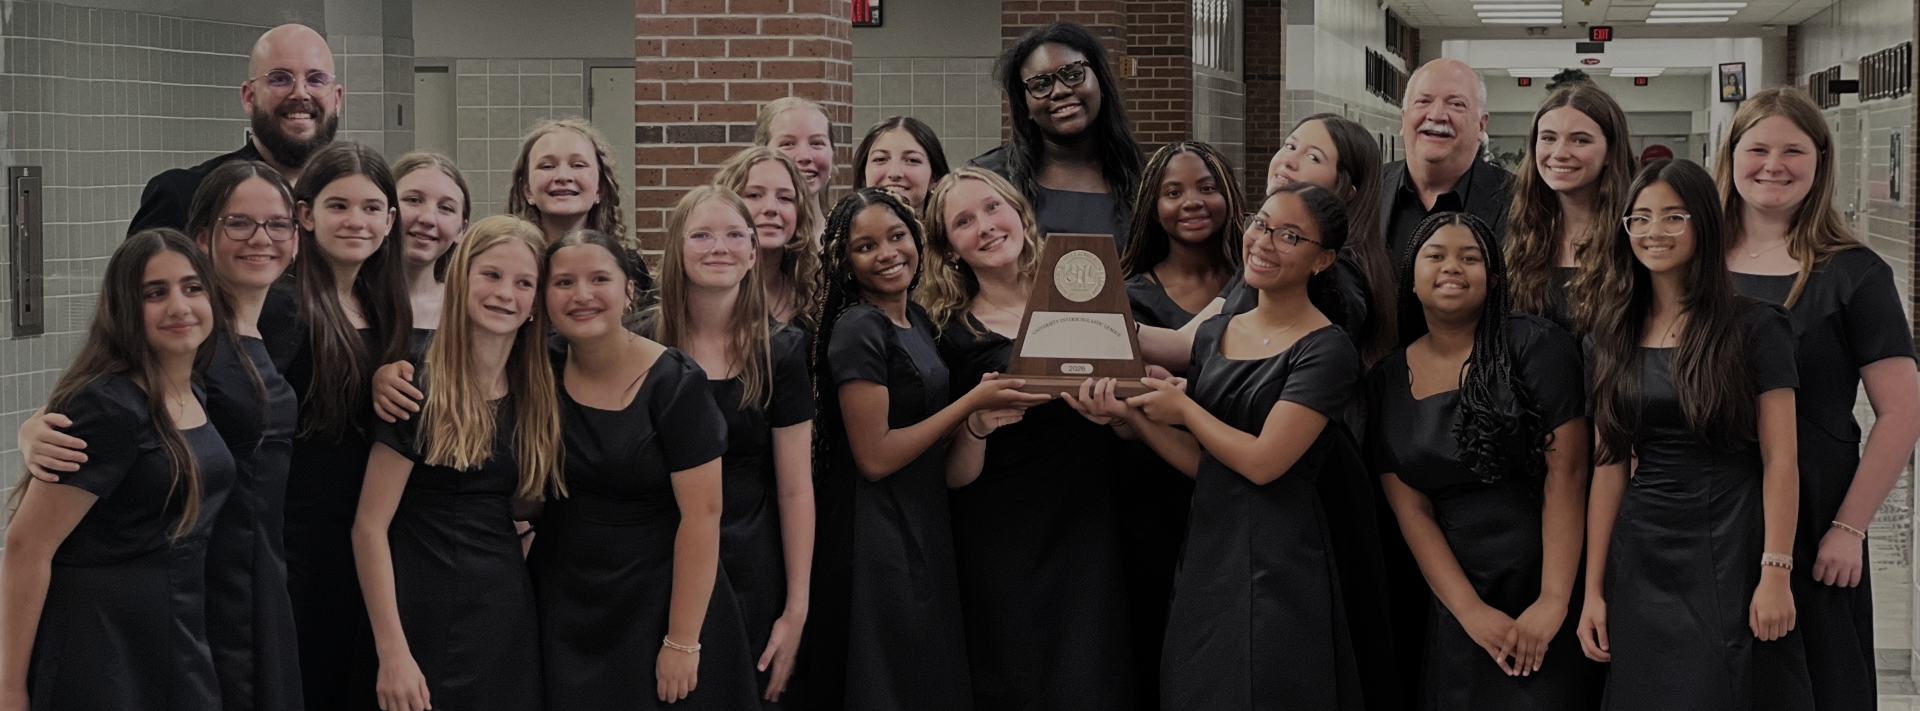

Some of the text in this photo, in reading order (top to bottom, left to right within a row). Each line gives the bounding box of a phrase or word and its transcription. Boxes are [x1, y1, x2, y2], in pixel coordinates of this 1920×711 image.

[1593, 28, 1610, 40] EXIT
[1031, 317, 1121, 338] UNIVERSITY INTERSCHOLASTIC LEAGUE
